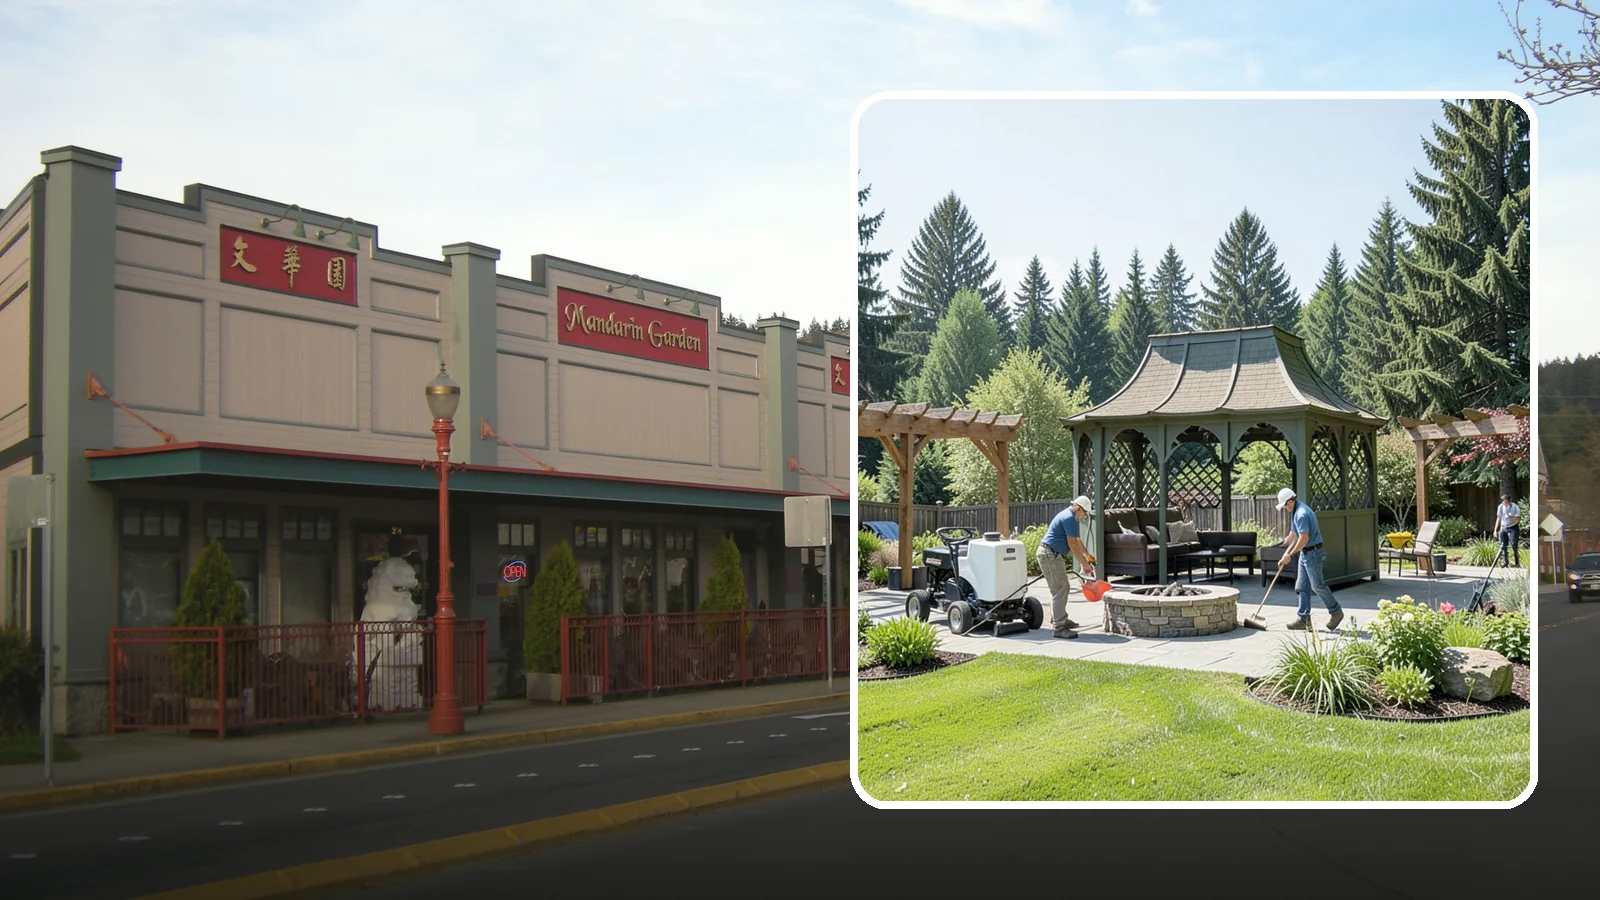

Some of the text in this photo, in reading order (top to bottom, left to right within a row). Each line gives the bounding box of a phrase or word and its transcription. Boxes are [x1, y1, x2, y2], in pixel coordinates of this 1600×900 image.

[230, 235, 346, 291] 文華園
[564, 302, 701, 352] Mandarin Garden
[503, 565, 527, 578] OPEN
